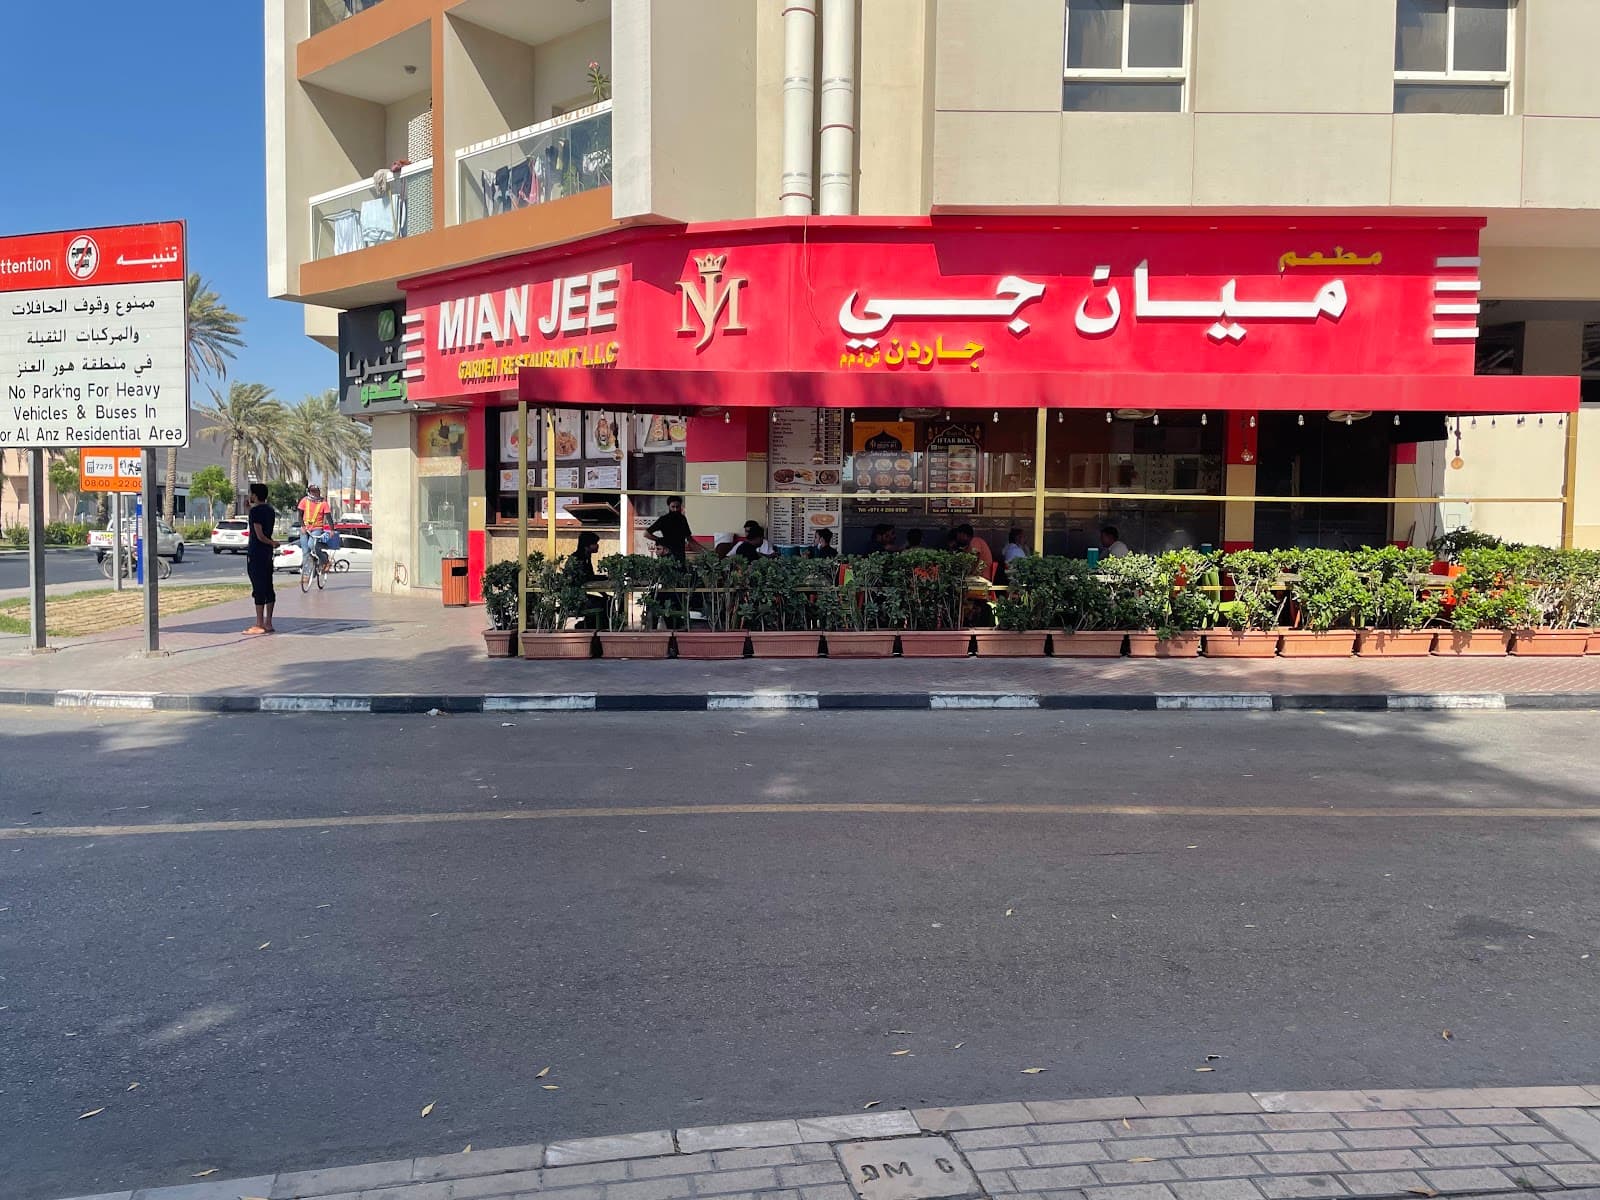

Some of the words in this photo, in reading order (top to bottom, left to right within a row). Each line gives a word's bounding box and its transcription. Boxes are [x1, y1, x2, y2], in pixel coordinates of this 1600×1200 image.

[0, 257, 51, 275] ttention
[116, 246, 178, 268] تنبيه
[1278, 246, 1382, 274] مطعم
[12, 298, 67, 316] الحافلات
[73, 296, 109, 315] وقوف
[115, 295, 155, 317] ممنوع
[1075, 259, 1348, 340] ميان
[437, 285, 529, 350] MIAN
[538, 269, 618, 334] JEE
[838, 275, 1046, 350] جي
[27, 329, 67, 347] الثقيلة
[76, 326, 139, 345] والمركبات
[885, 335, 984, 368] جاردن
[16, 359, 45, 378] العنز
[52, 361, 75, 376] هور
[82, 356, 126, 371] منطقة
[134, 354, 153, 378] في
[458, 357, 497, 380] GARDEN
[501, 348, 578, 375] RESTAURANT
[8, 385, 26, 400] No
[33, 383, 81, 401] Parking
[88, 383, 109, 398] For
[116, 382, 160, 399] Heavy
[14, 406, 68, 421] Vehicles
[76, 404, 86, 419] &
[96, 404, 137, 419] Buses
[145, 404, 157, 419] In
[0, 430, 11, 442] or
[16, 426, 30, 442] Al
[36, 426, 59, 441] Anz
[66, 425, 140, 441] Residential
[149, 425, 182, 441] Area
[95, 463, 113, 471] 7275
